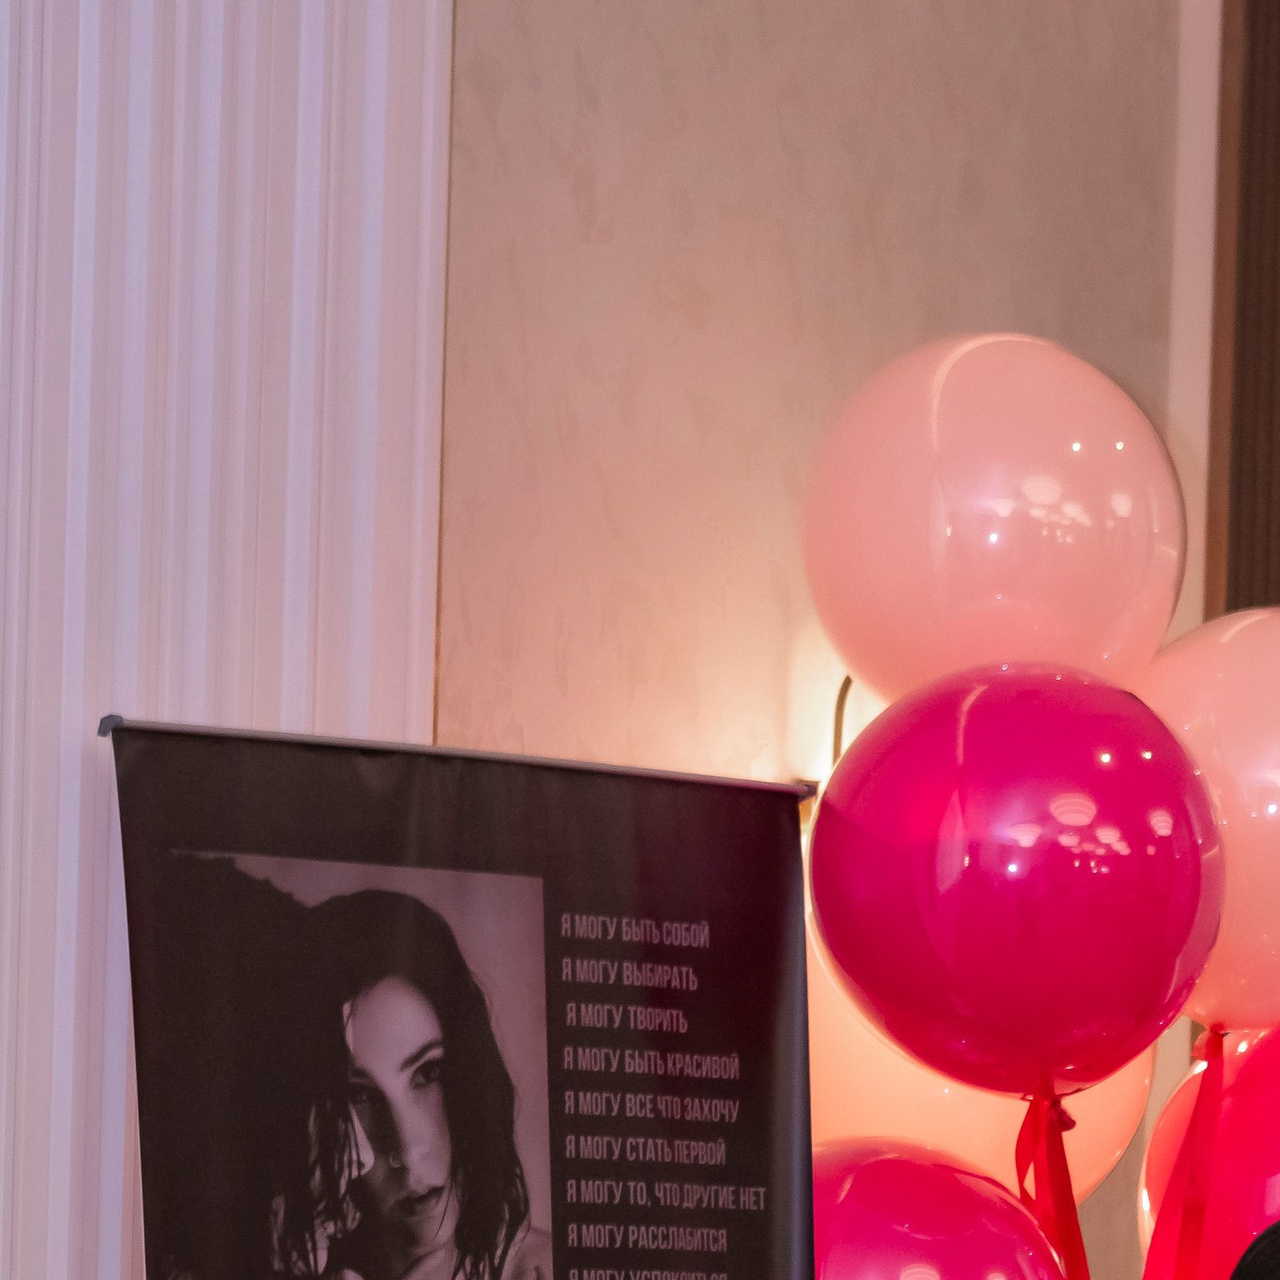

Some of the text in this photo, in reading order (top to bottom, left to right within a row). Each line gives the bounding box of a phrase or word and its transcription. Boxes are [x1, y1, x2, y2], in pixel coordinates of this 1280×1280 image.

[562, 914, 709, 948] Я МОГУ БЫТЬ СОБОЙ
[562, 958, 698, 991] Я МОГУ ВЫБИРАТЬ
[567, 1003, 688, 1033] Я МОГУ ТВОРИТЬ
[564, 1047, 739, 1079] Я МОГУ БЫТЬ КРАСИВОЙ
[565, 1092, 739, 1123] Я МОГУ ВСЕ ЧТО ЗАХОЧУ
[566, 1136, 725, 1166] Я МОГУ СТАТЬ ПЕРВОЙ
[567, 1180, 766, 1210] Я МОГУ ТО, ЧТО ДРУГИЕ НЕТ
[568, 1224, 577, 1246] Я
[582, 1225, 623, 1248] МОГУ
